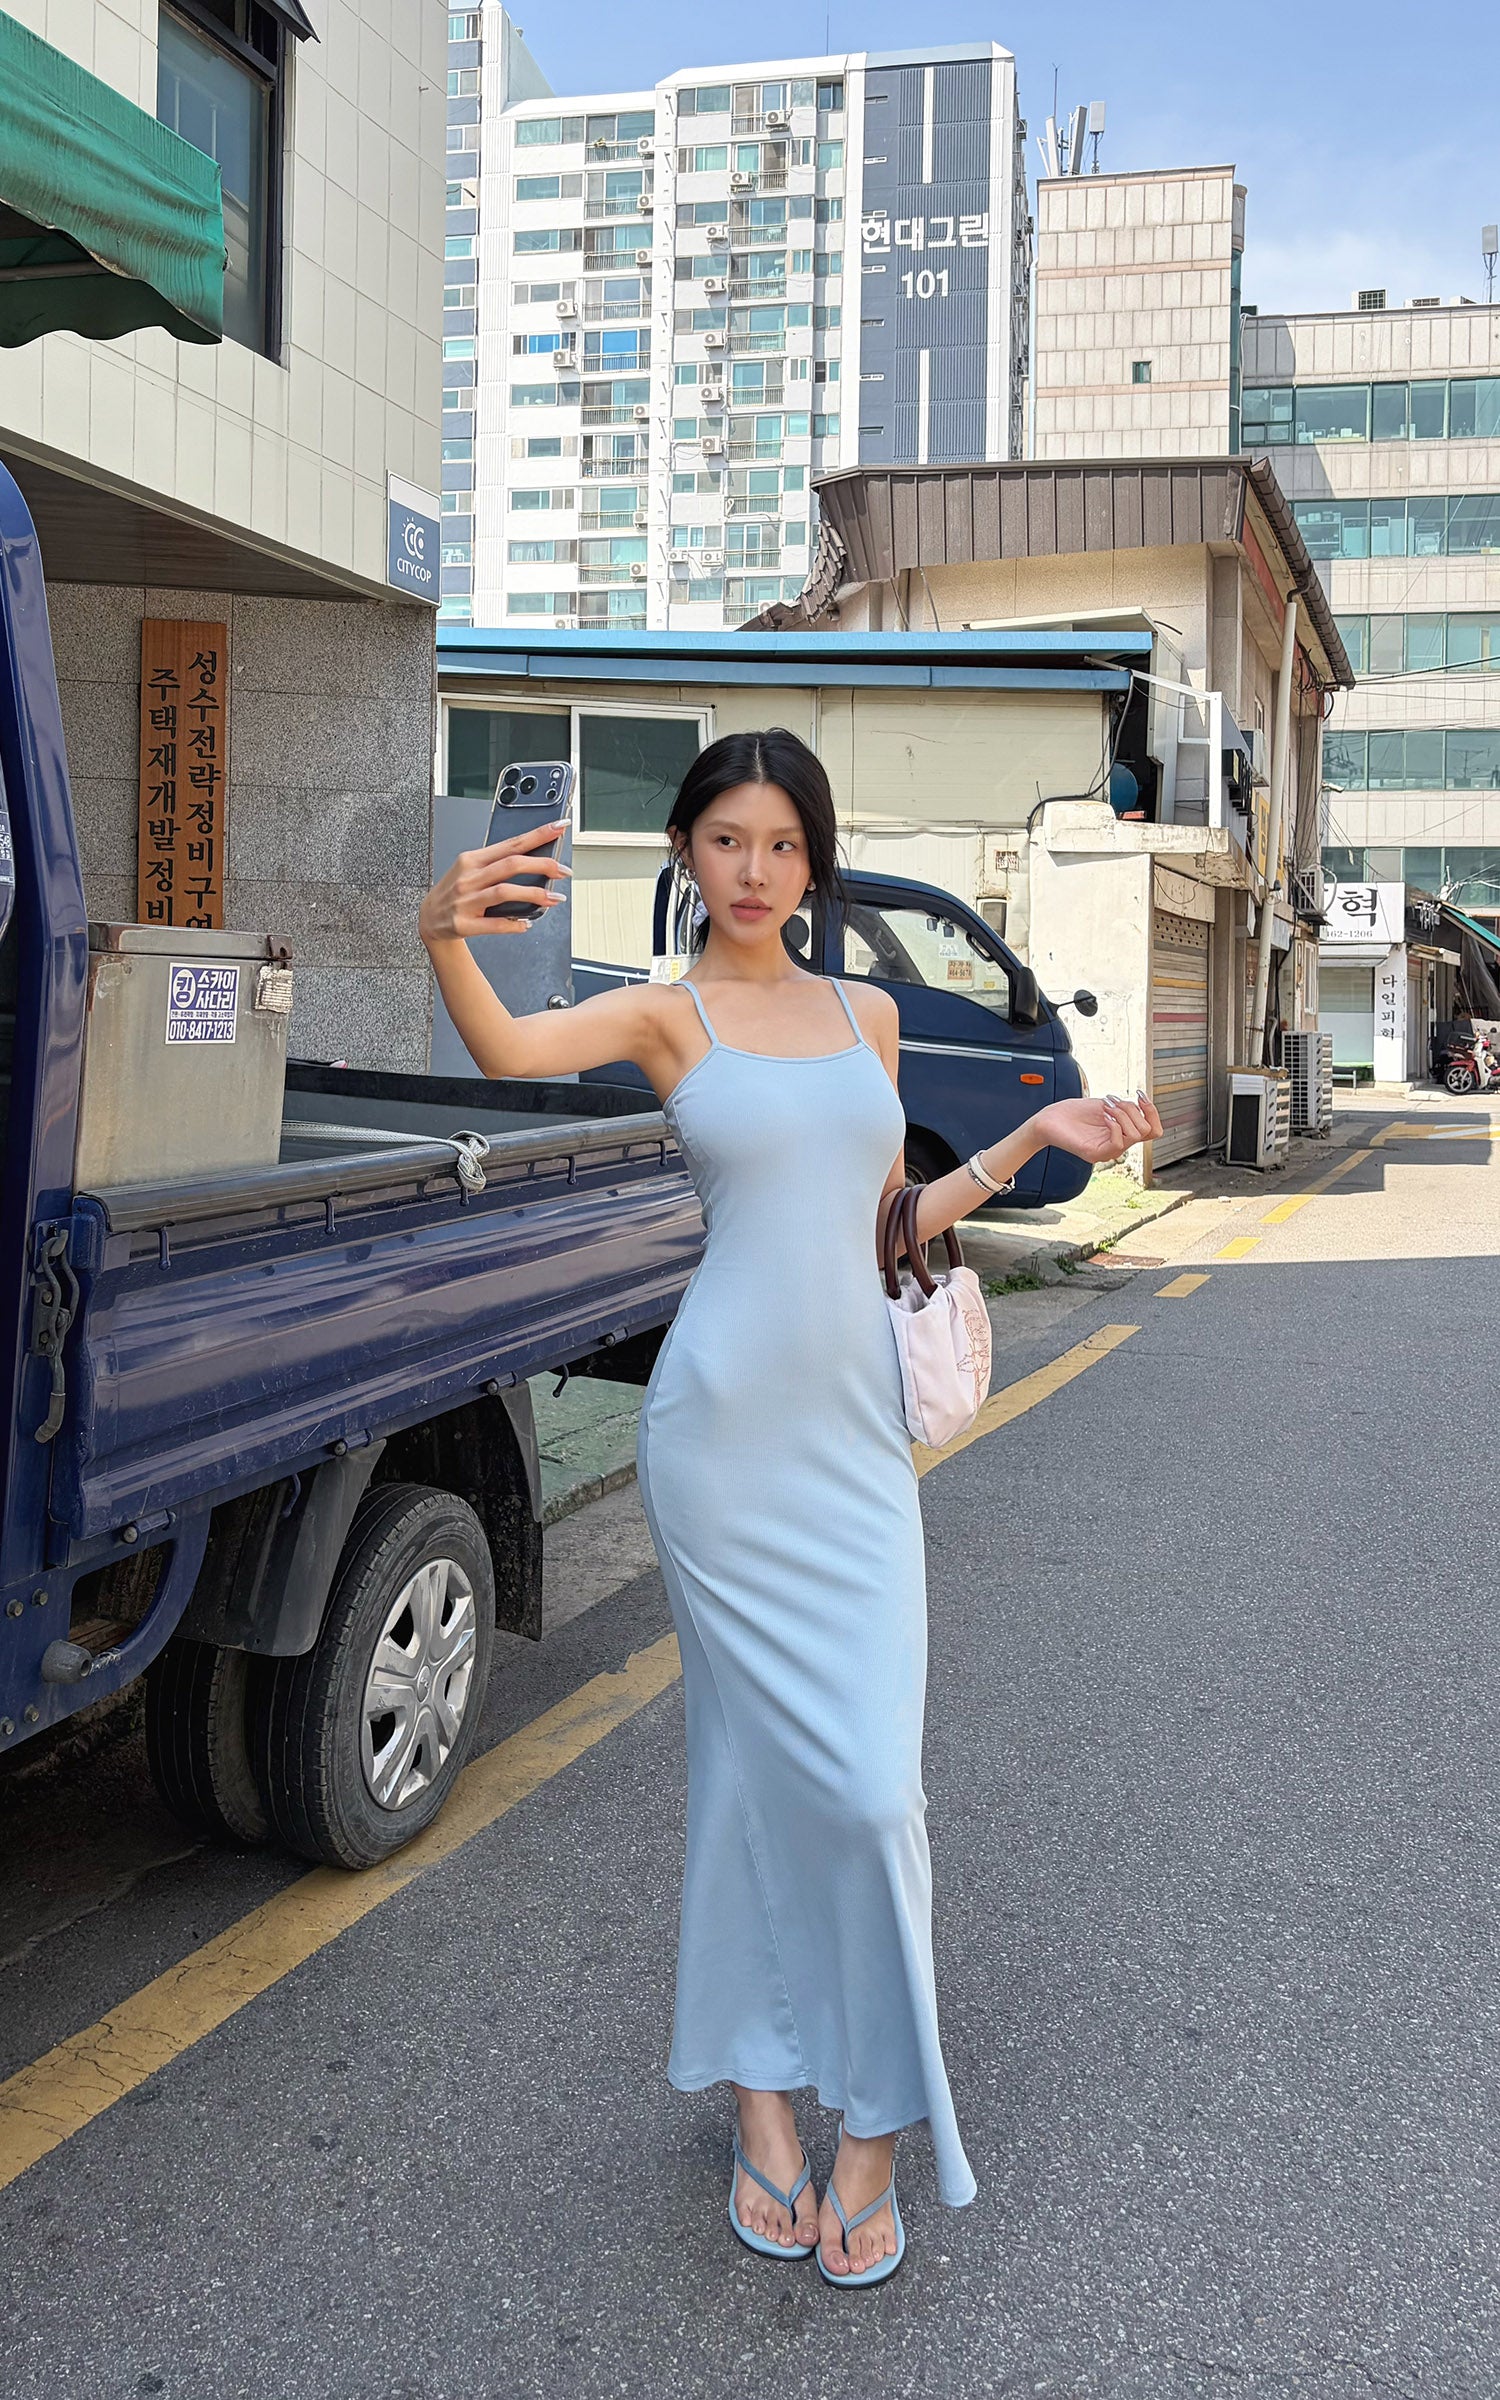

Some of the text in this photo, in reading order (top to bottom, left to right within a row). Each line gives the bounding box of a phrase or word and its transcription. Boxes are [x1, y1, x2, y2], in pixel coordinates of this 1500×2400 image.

[861, 212, 989, 253] 현대그린
[901, 268, 949, 299] 101
[396, 557, 432, 583] CITYCOP
[145, 668, 182, 926] 주택재개발정비
[1336, 887, 1379, 928] 혁
[175, 975, 194, 1003] 킹
[197, 970, 236, 989] 스카이
[195, 990, 235, 1009] 사다리
